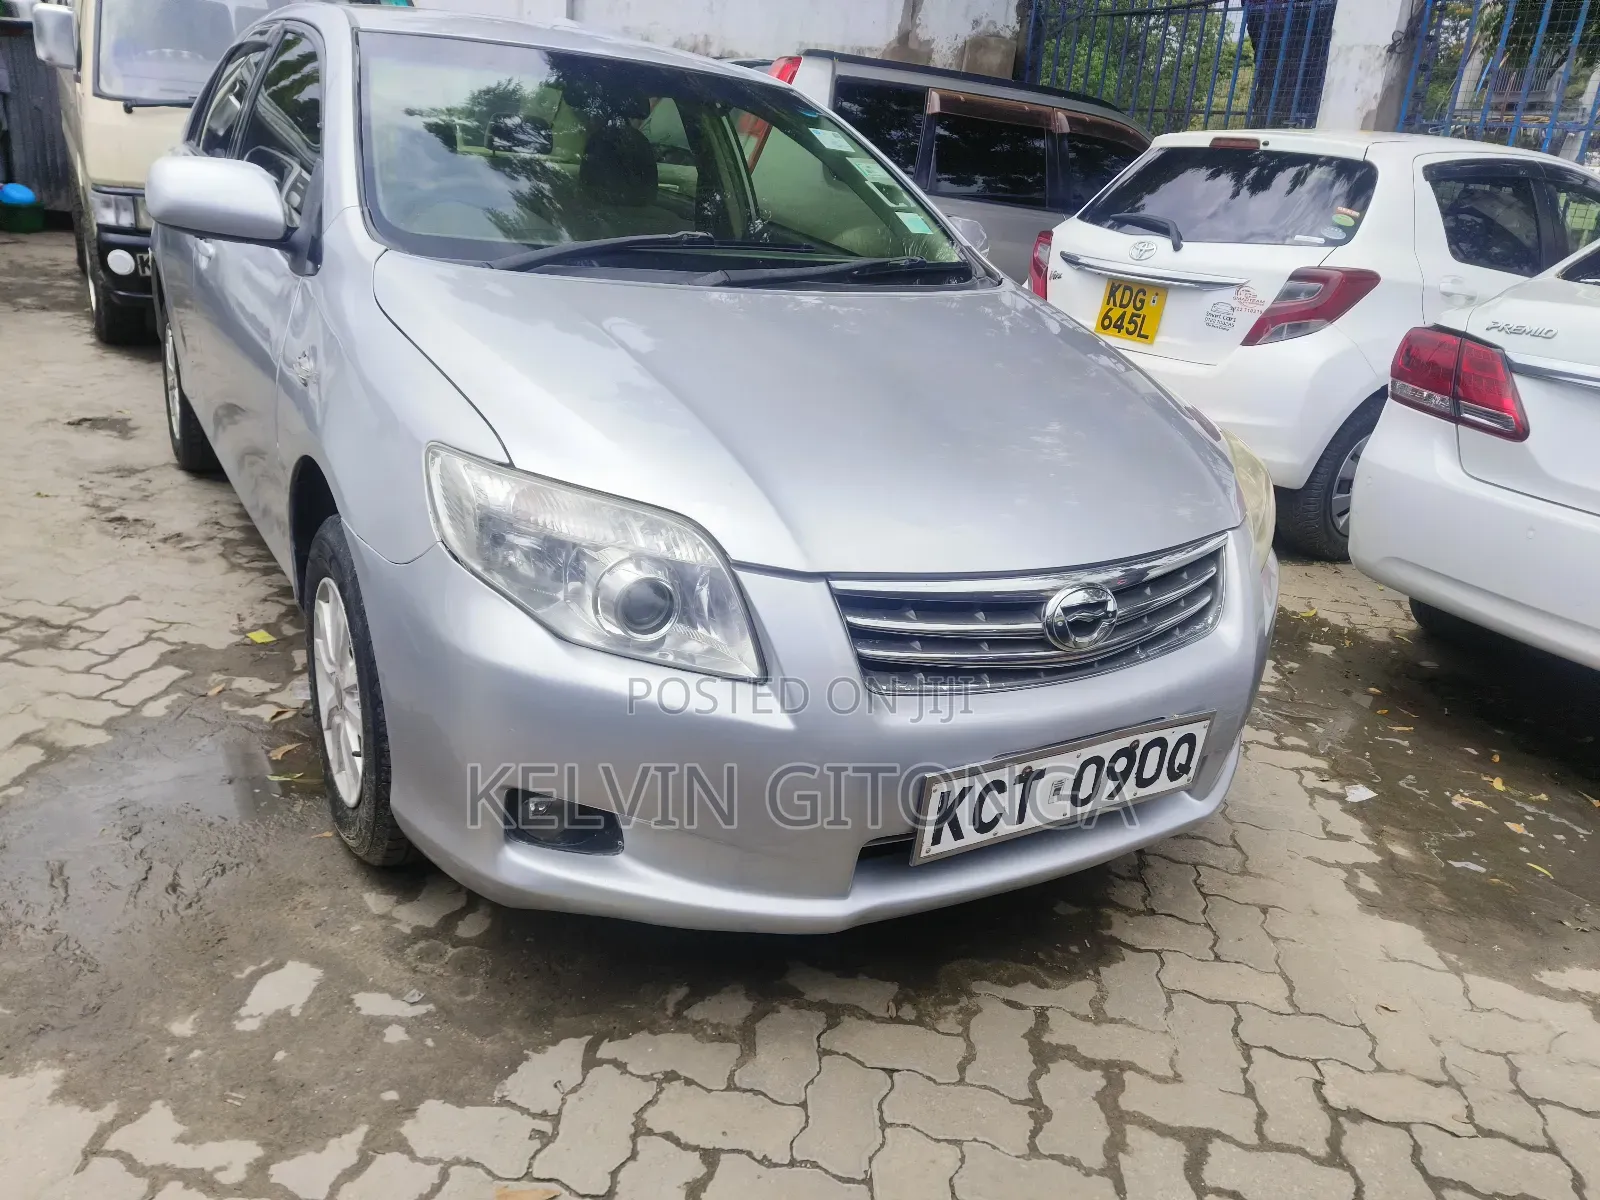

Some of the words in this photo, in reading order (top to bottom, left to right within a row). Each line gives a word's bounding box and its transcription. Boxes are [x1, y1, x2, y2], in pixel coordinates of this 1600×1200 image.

[1106, 281, 1147, 312] KDG
[1100, 307, 1149, 340] 645L
[1485, 321, 1558, 339] PREMIO
[931, 768, 1046, 847] KCT
[1070, 732, 1197, 808] 090Q
